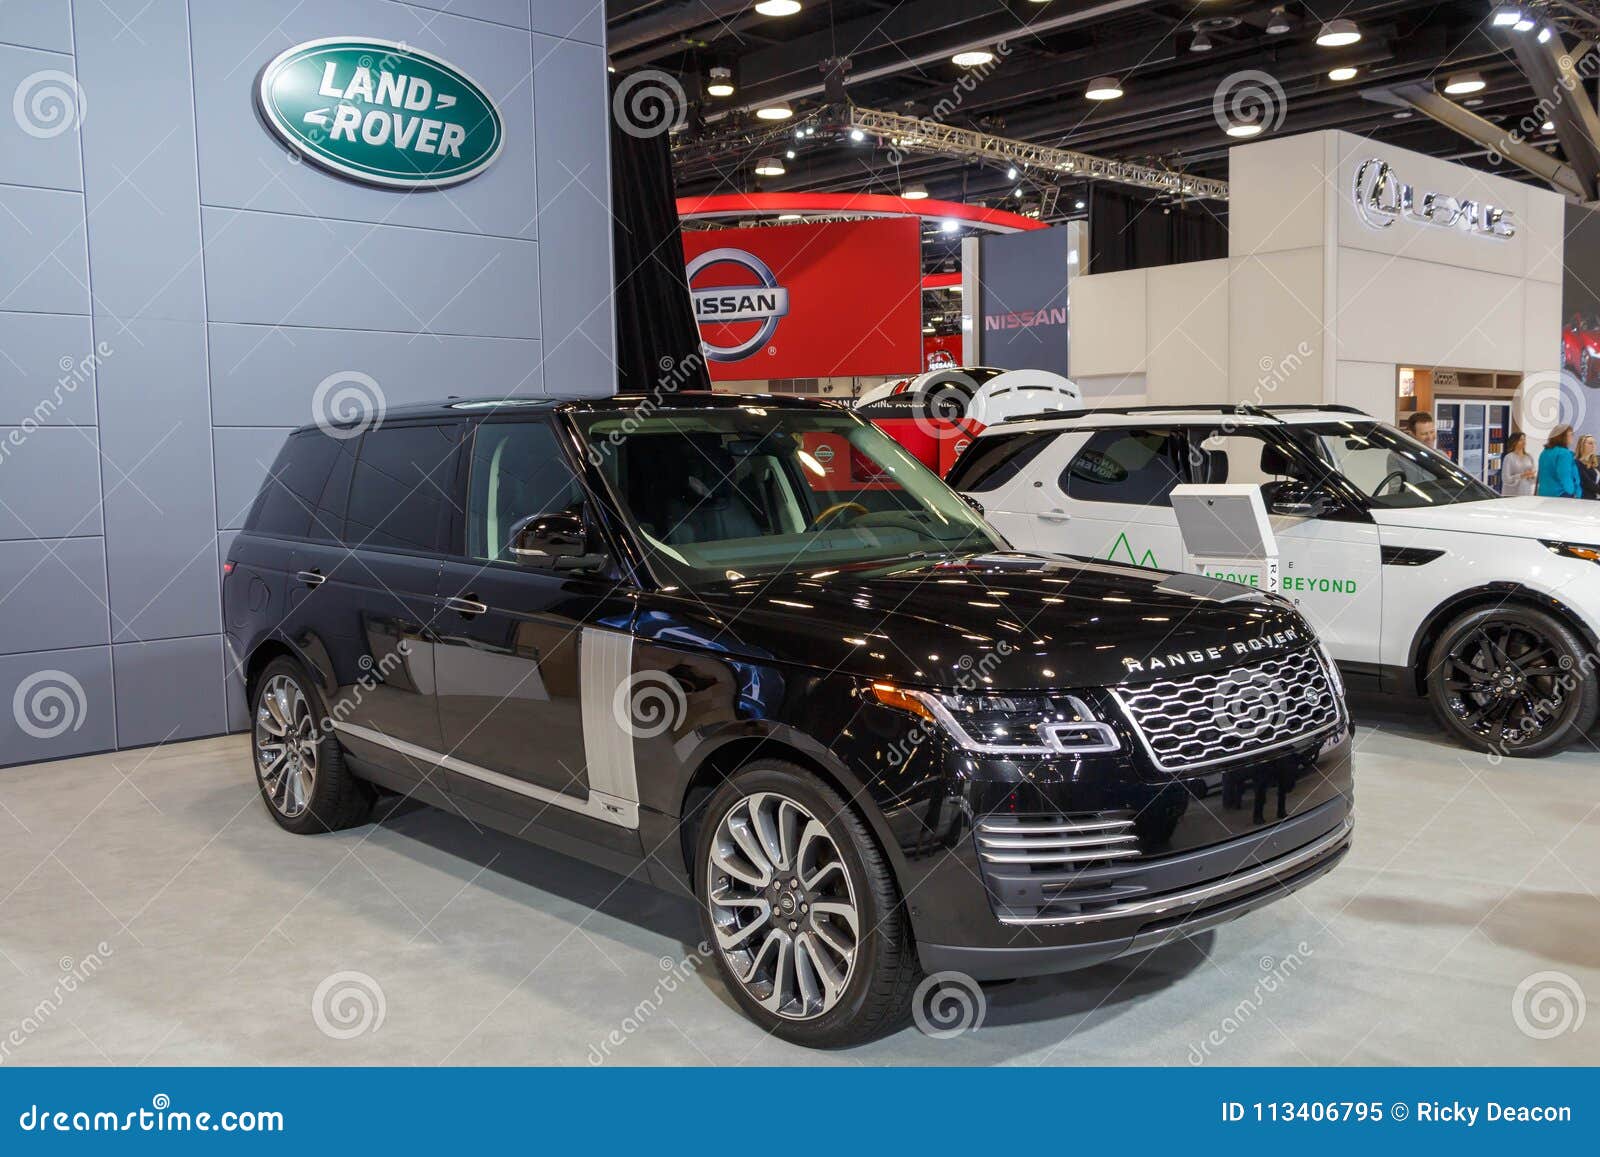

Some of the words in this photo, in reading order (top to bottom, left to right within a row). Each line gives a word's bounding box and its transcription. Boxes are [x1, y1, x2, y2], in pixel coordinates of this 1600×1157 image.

[318, 61, 433, 112] LAND
[330, 104, 467, 159] ROVER
[1402, 184, 1516, 240] LEXUS
[694, 294, 776, 315] ISSAN
[985, 307, 1066, 331] NISSAN
[1282, 577, 1357, 594] BEYOND
[1126, 647, 1222, 673] RANGE
[1232, 629, 1299, 655] ROVER
